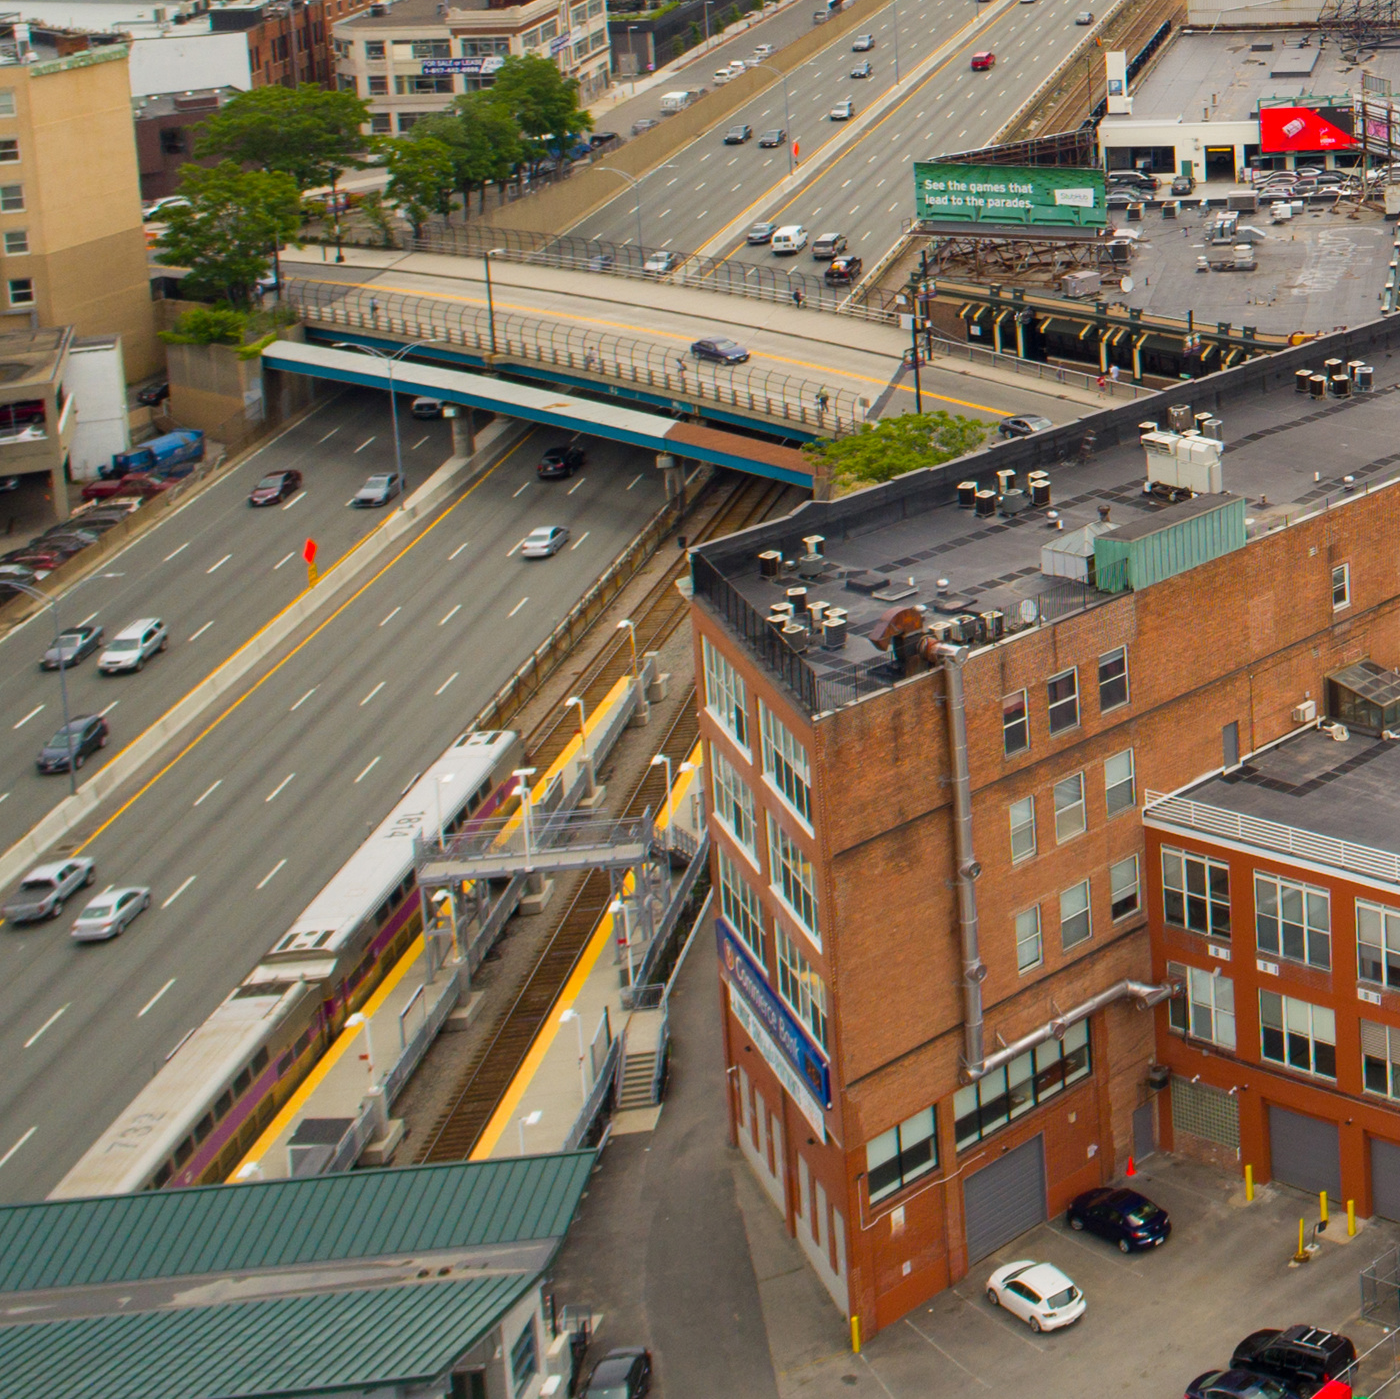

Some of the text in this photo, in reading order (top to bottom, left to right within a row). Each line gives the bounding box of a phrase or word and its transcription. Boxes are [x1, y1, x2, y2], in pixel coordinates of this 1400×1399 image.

[1111, 81, 1119, 90] P
[924, 179, 1034, 194] See the games that
[925, 194, 1035, 209] lead to the parades.
[1060, 193, 1089, 201] StubHub
[385, 810, 427, 839] 1814
[735, 955, 801, 1063] Commerce Bank
[105, 1111, 168, 1154] 732
